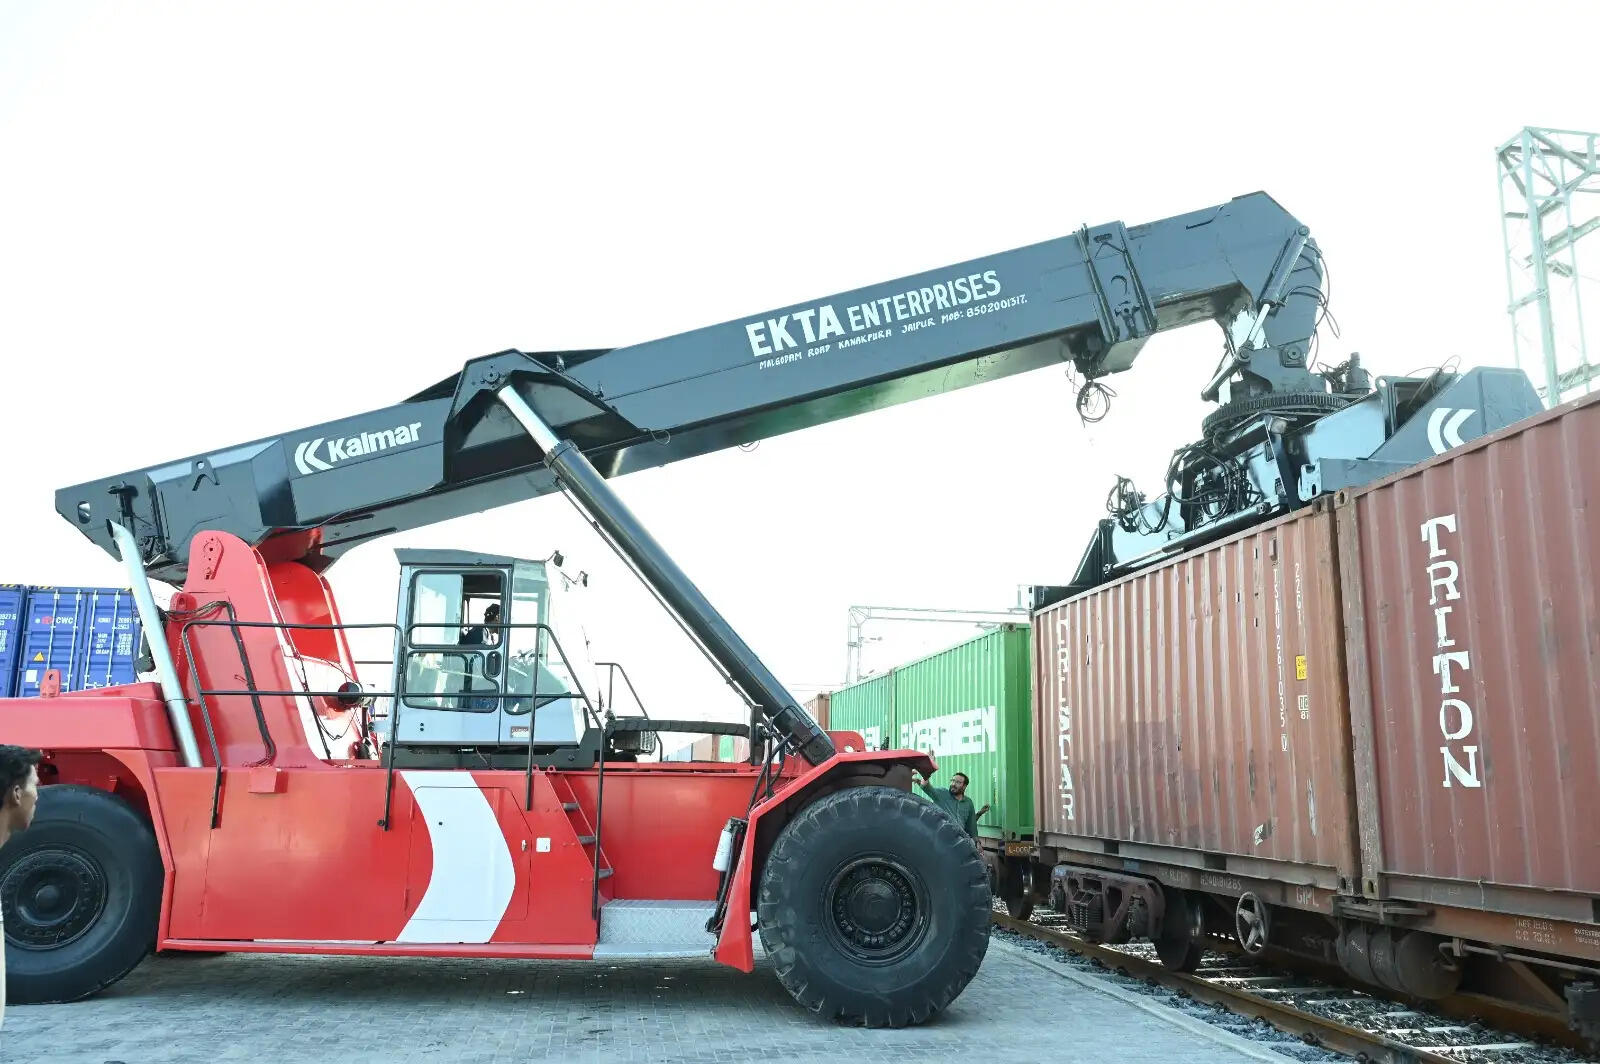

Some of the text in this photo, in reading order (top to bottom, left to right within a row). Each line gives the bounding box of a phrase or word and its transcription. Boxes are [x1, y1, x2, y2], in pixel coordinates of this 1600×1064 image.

[744, 270, 1001, 357] EKTA ENTERPRISES
[901, 317, 936, 334] JAIPUR
[327, 421, 422, 463] Kalmar
[55, 616, 74, 624] CWC
[1420, 513, 1481, 788] TRITON
